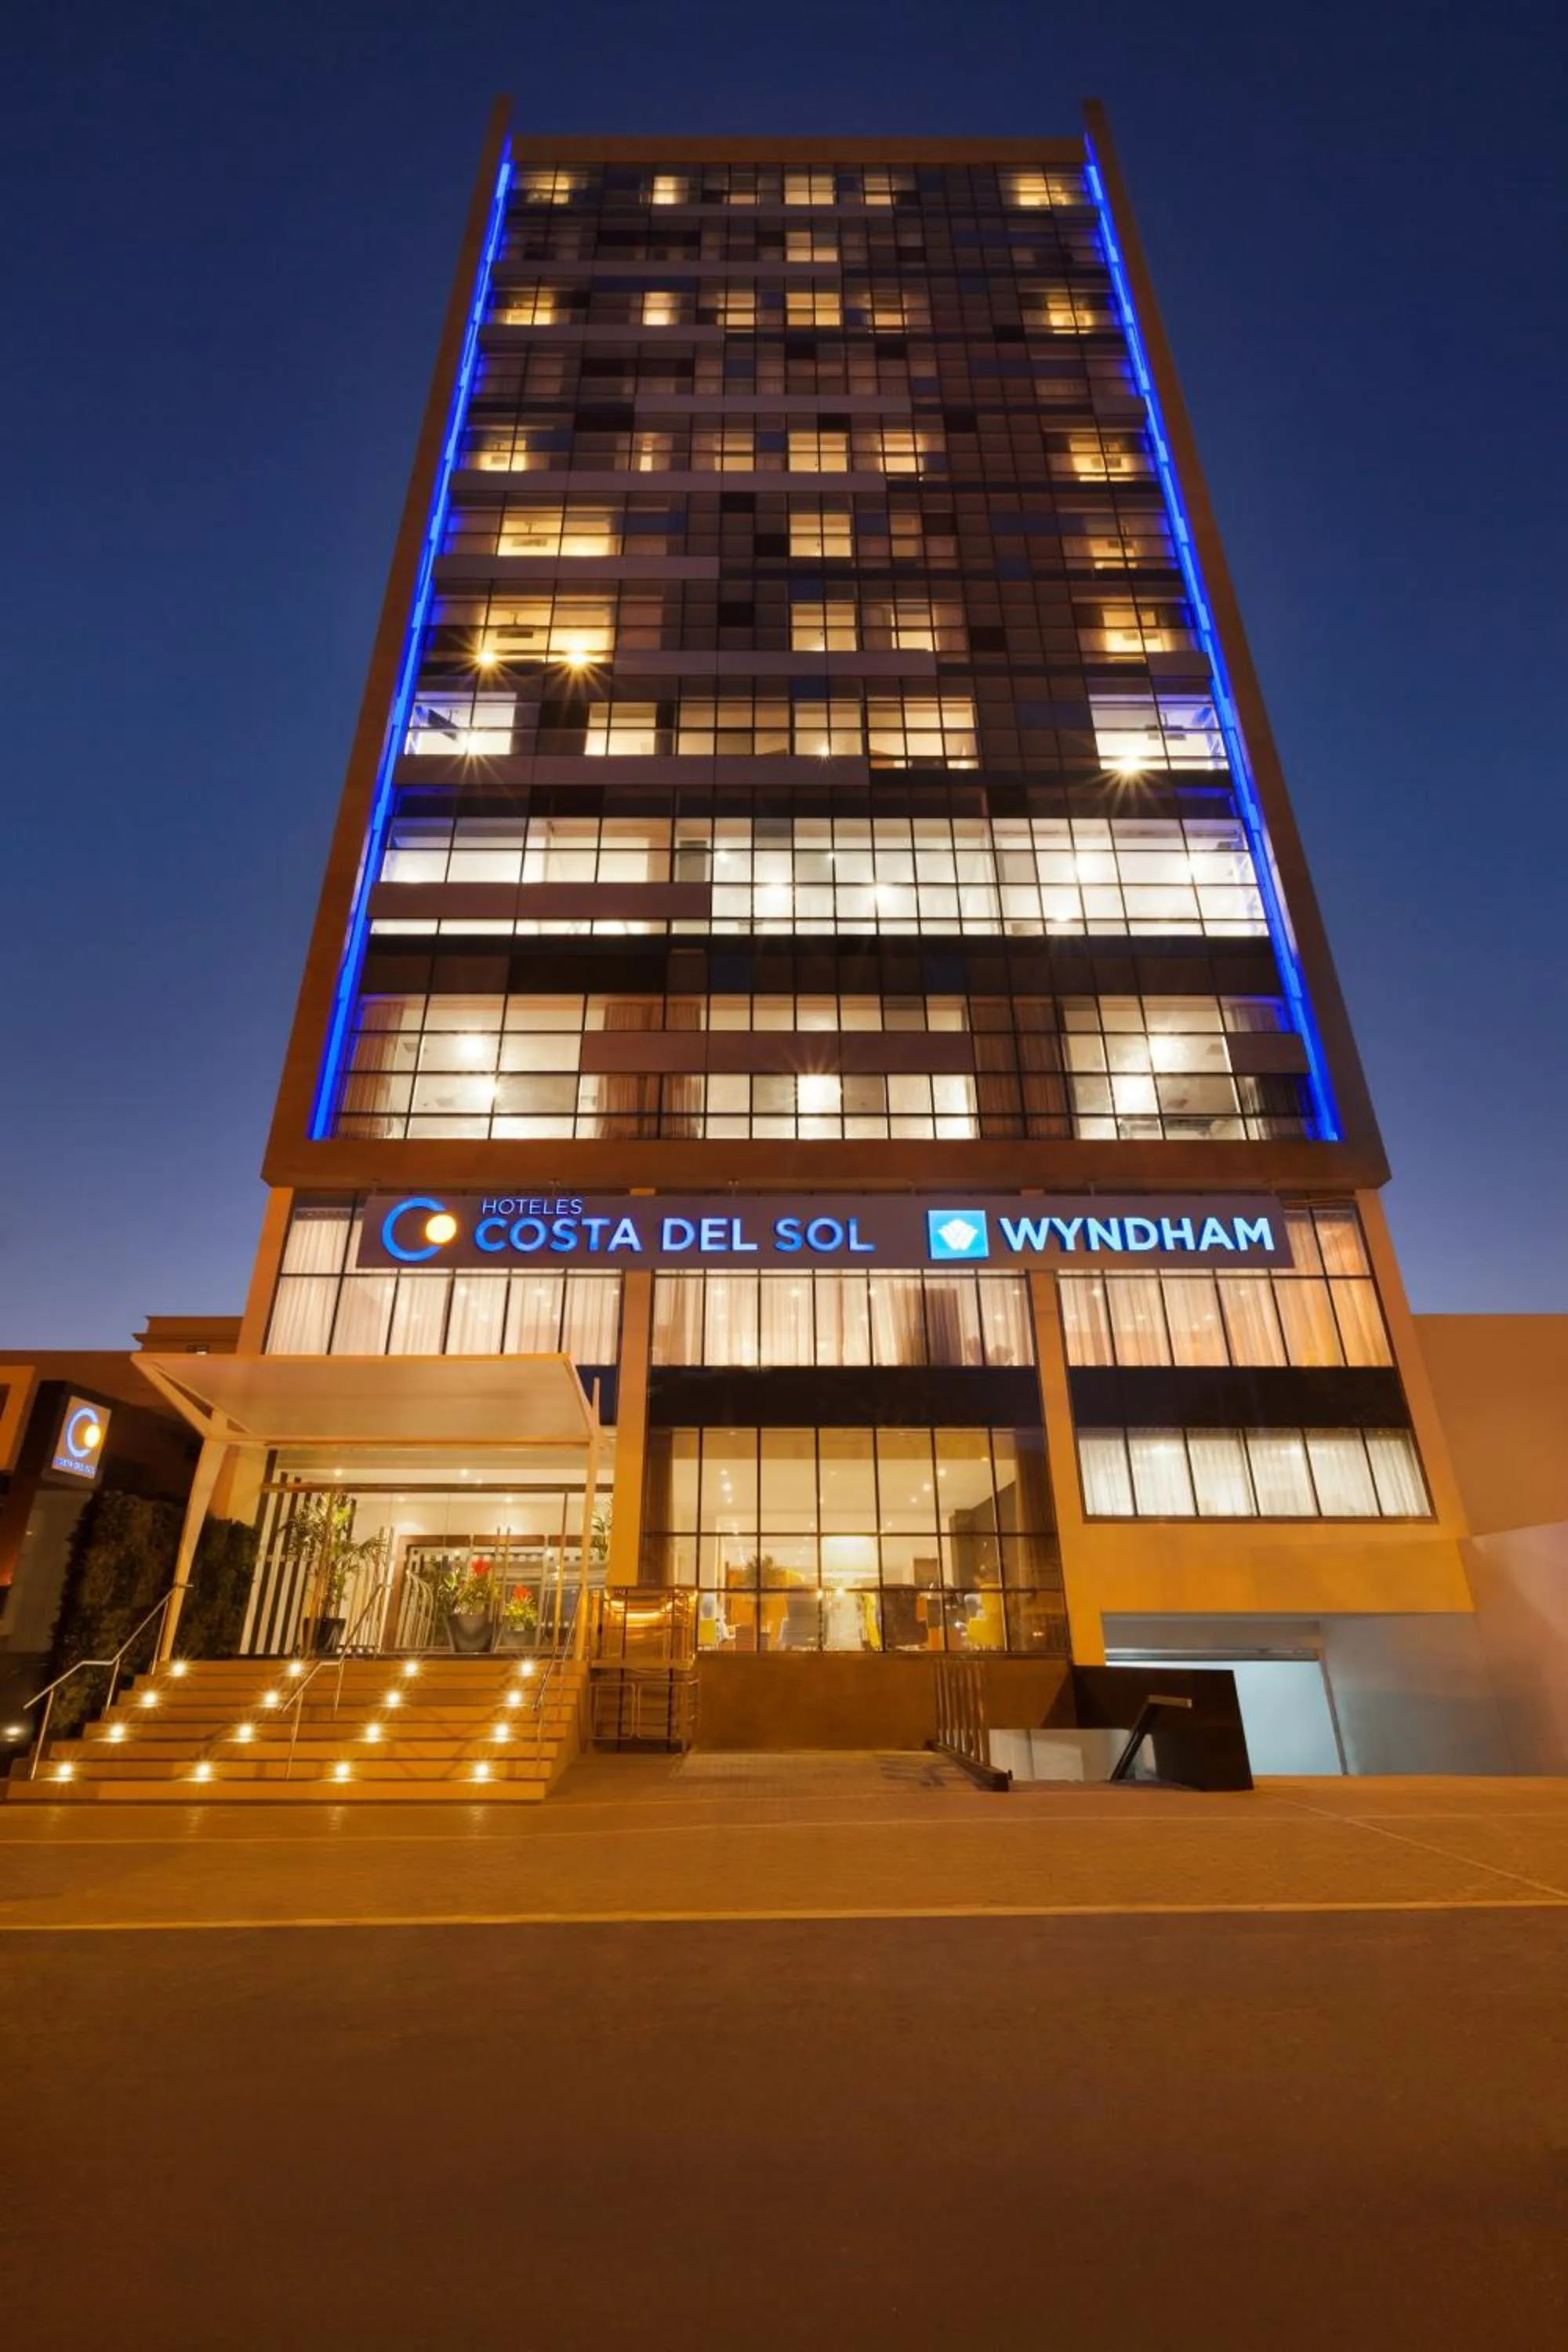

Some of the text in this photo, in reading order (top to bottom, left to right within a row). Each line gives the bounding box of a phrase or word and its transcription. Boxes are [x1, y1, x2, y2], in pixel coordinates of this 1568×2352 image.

[481, 1198, 583, 1215] HOTELES
[474, 1216, 875, 1252] COSTA DEL SOL
[999, 1216, 1276, 1253] WYNDHAM
